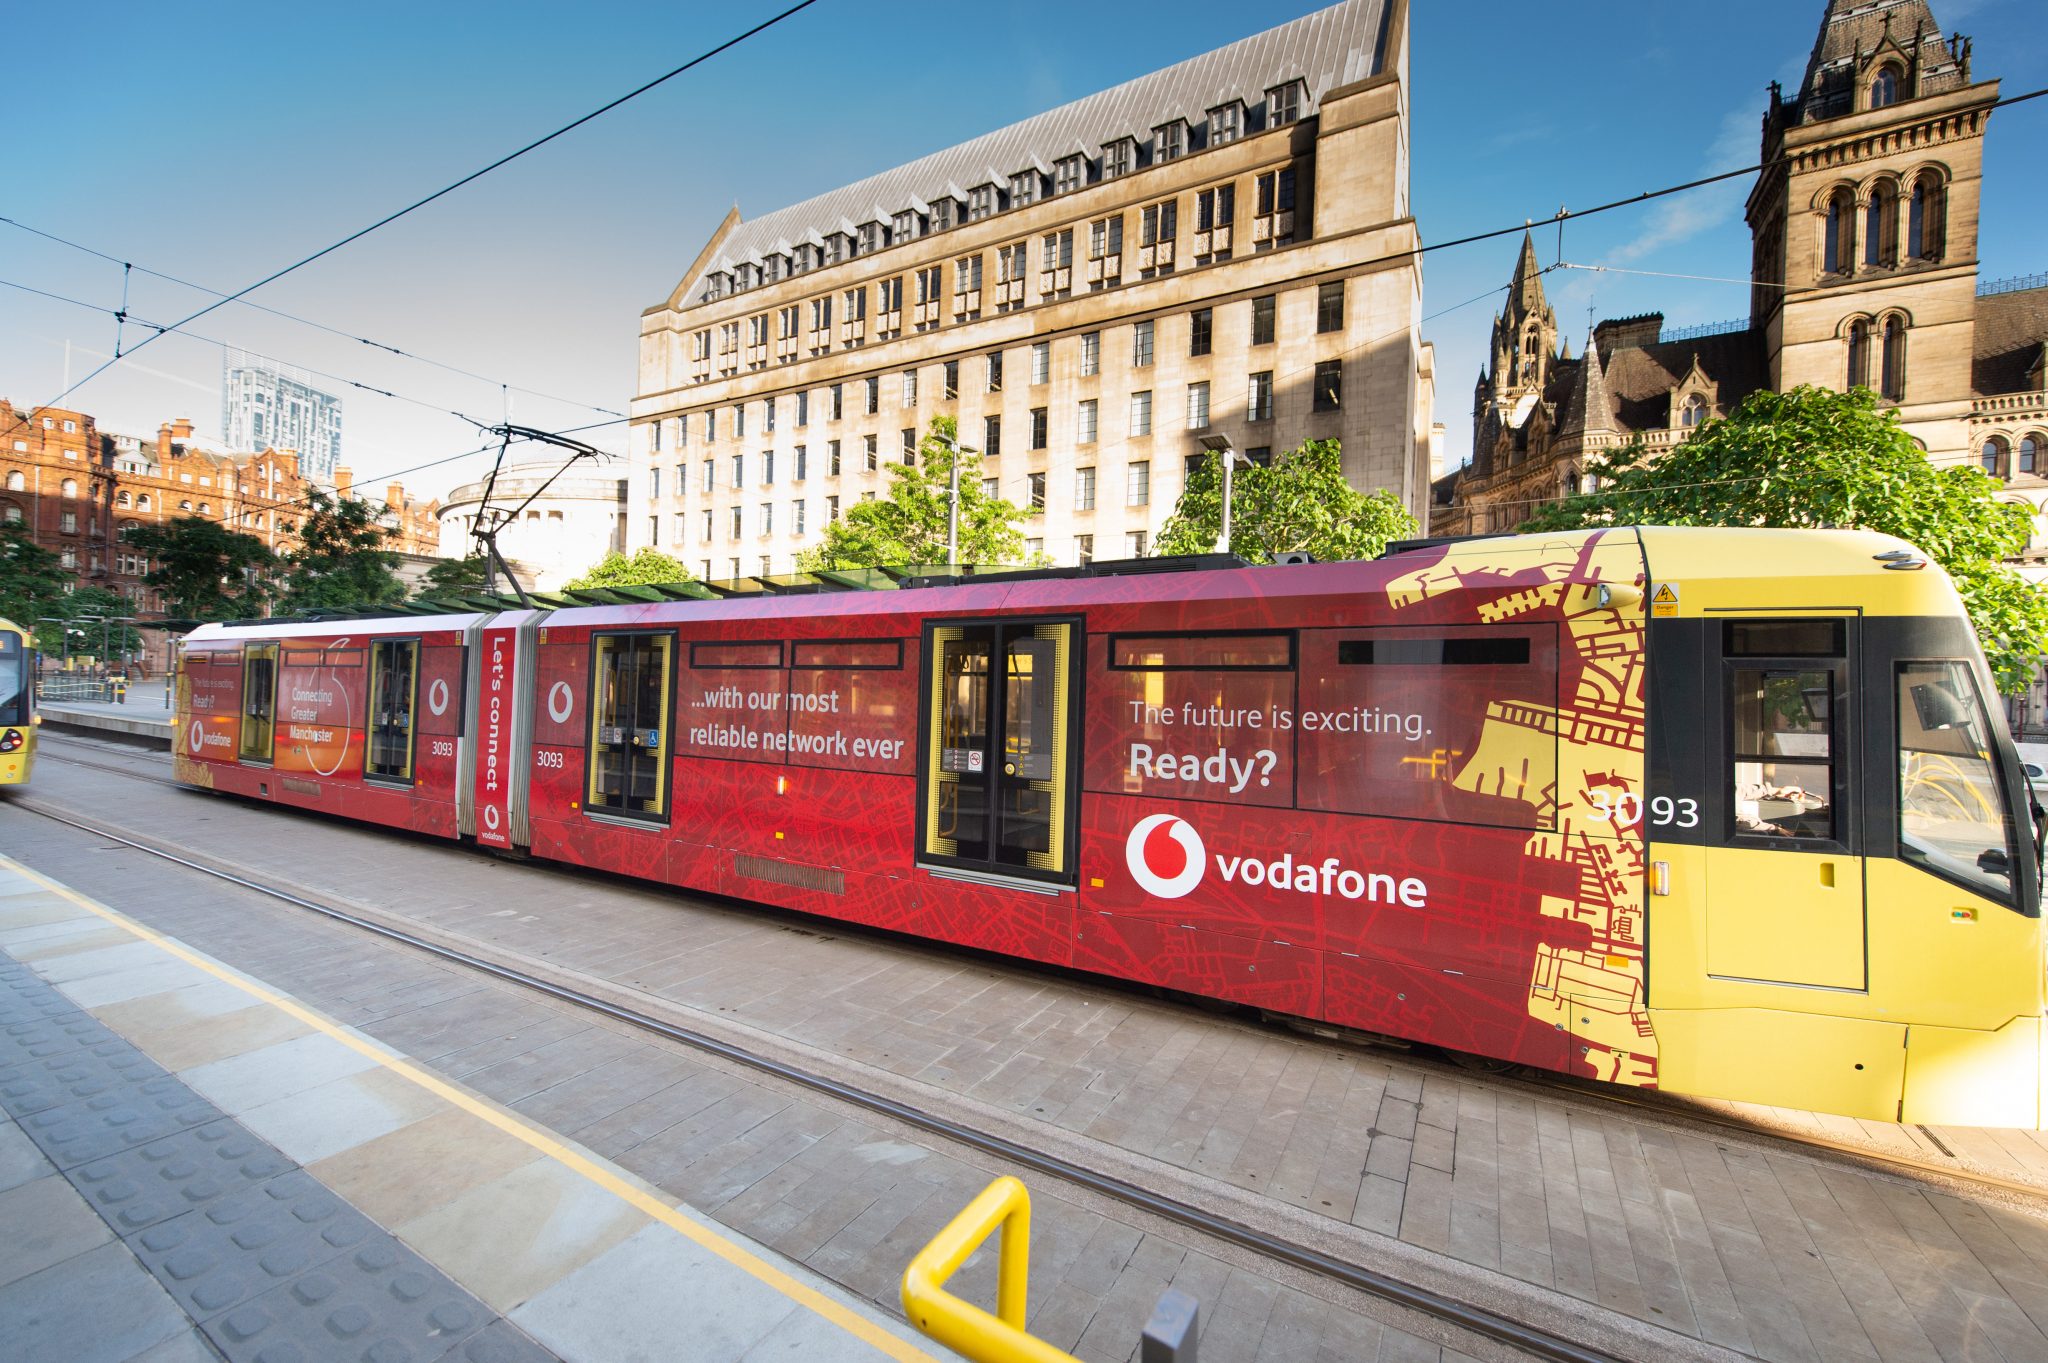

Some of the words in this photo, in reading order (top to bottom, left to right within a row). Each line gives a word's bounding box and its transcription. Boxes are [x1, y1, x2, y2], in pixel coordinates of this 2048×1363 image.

[492, 637, 506, 691] Let's
[193, 694, 215, 711] Ready?
[292, 687, 333, 706] Connecting
[747, 691, 781, 711] our
[785, 689, 839, 713] most
[291, 706, 317, 721] Greater
[1129, 701, 1174, 725] The
[1182, 702, 1263, 729] future
[1272, 705, 1292, 729] is
[1302, 706, 1432, 741] exciting.
[203, 732, 232, 747] vodafone
[290, 725, 333, 742] Manchester
[486, 696, 500, 791] connect
[690, 724, 758, 749] reliable
[762, 730, 847, 756] network
[852, 735, 904, 760] ever
[432, 741, 453, 757] 3093
[537, 751, 563, 769] 3093
[1130, 743, 1277, 793] Ready?
[1586, 789, 1699, 828] 3093
[481, 831, 505, 842] vodafone
[1215, 853, 1428, 908] vodafone
